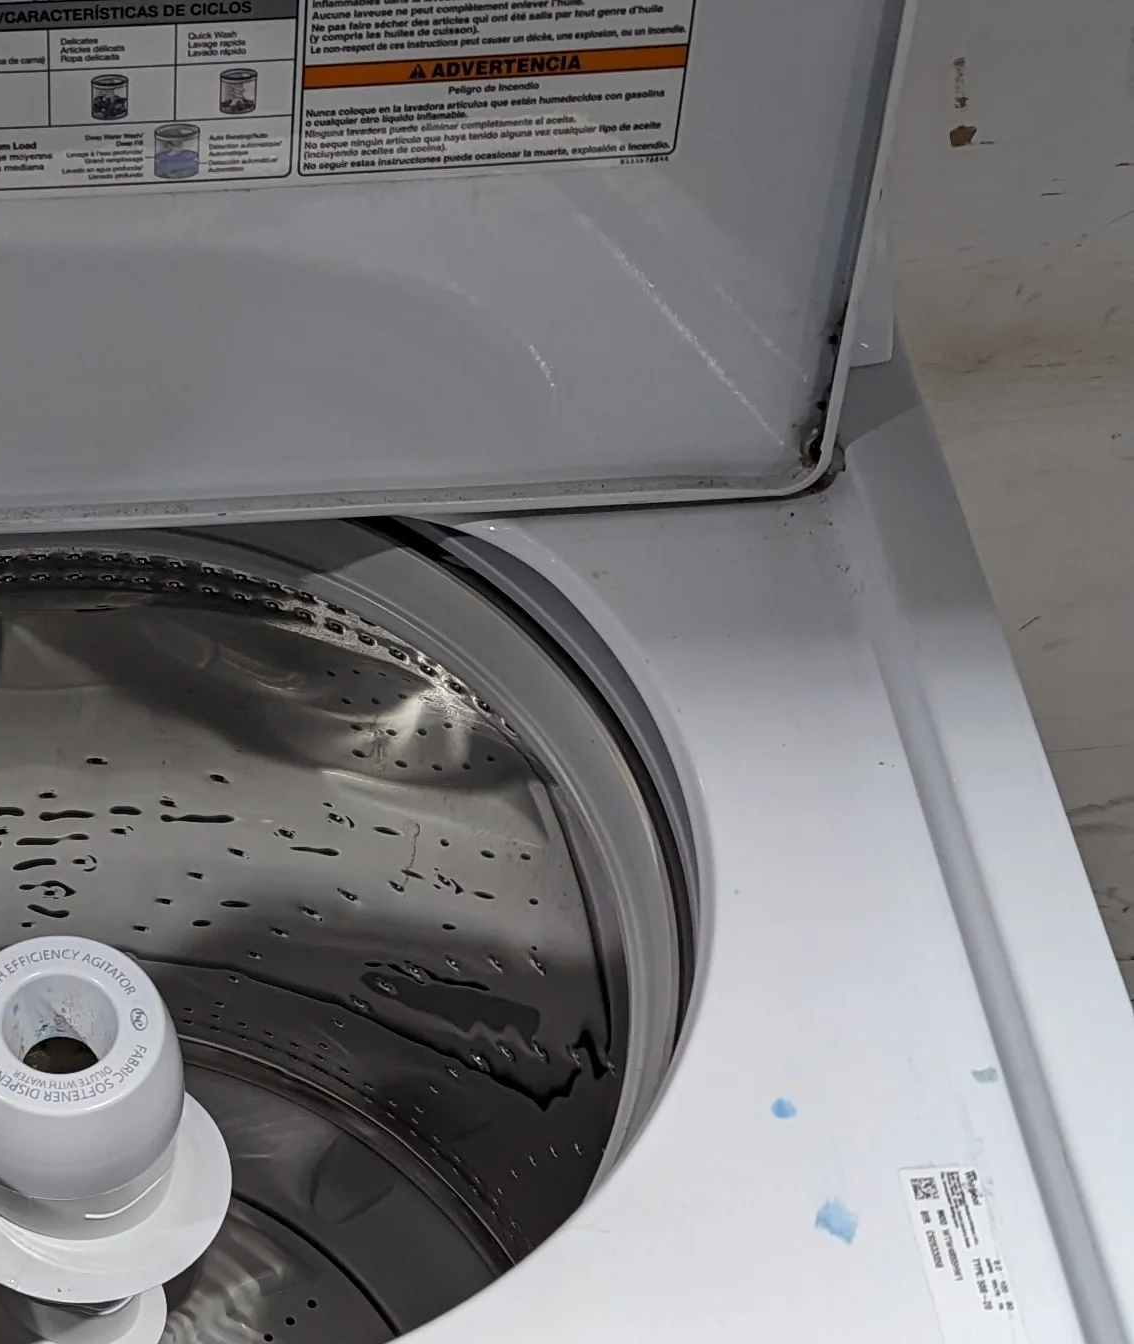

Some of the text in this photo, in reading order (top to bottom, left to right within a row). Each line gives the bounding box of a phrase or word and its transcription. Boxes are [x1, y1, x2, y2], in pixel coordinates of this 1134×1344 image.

[163, 4, 184, 16] DE
[190, 1, 251, 15] CICLOS
[187, 32, 212, 40] Quick
[431, 55, 582, 77] ADVERTENCIA
[447, 81, 540, 95] Peligro de incendio
[12, 141, 37, 150] Load
[9, 153, 53, 161] moyenne
[3, 163, 44, 171] mediana
[4, 949, 80, 975] EFFICIENCY
[82, 954, 137, 995] AGITATOR
[114, 1044, 148, 1084] FABRIC
[13, 1066, 112, 1090] DILUTE WITH WATER
[44, 1078, 114, 1102] SOFTENER
